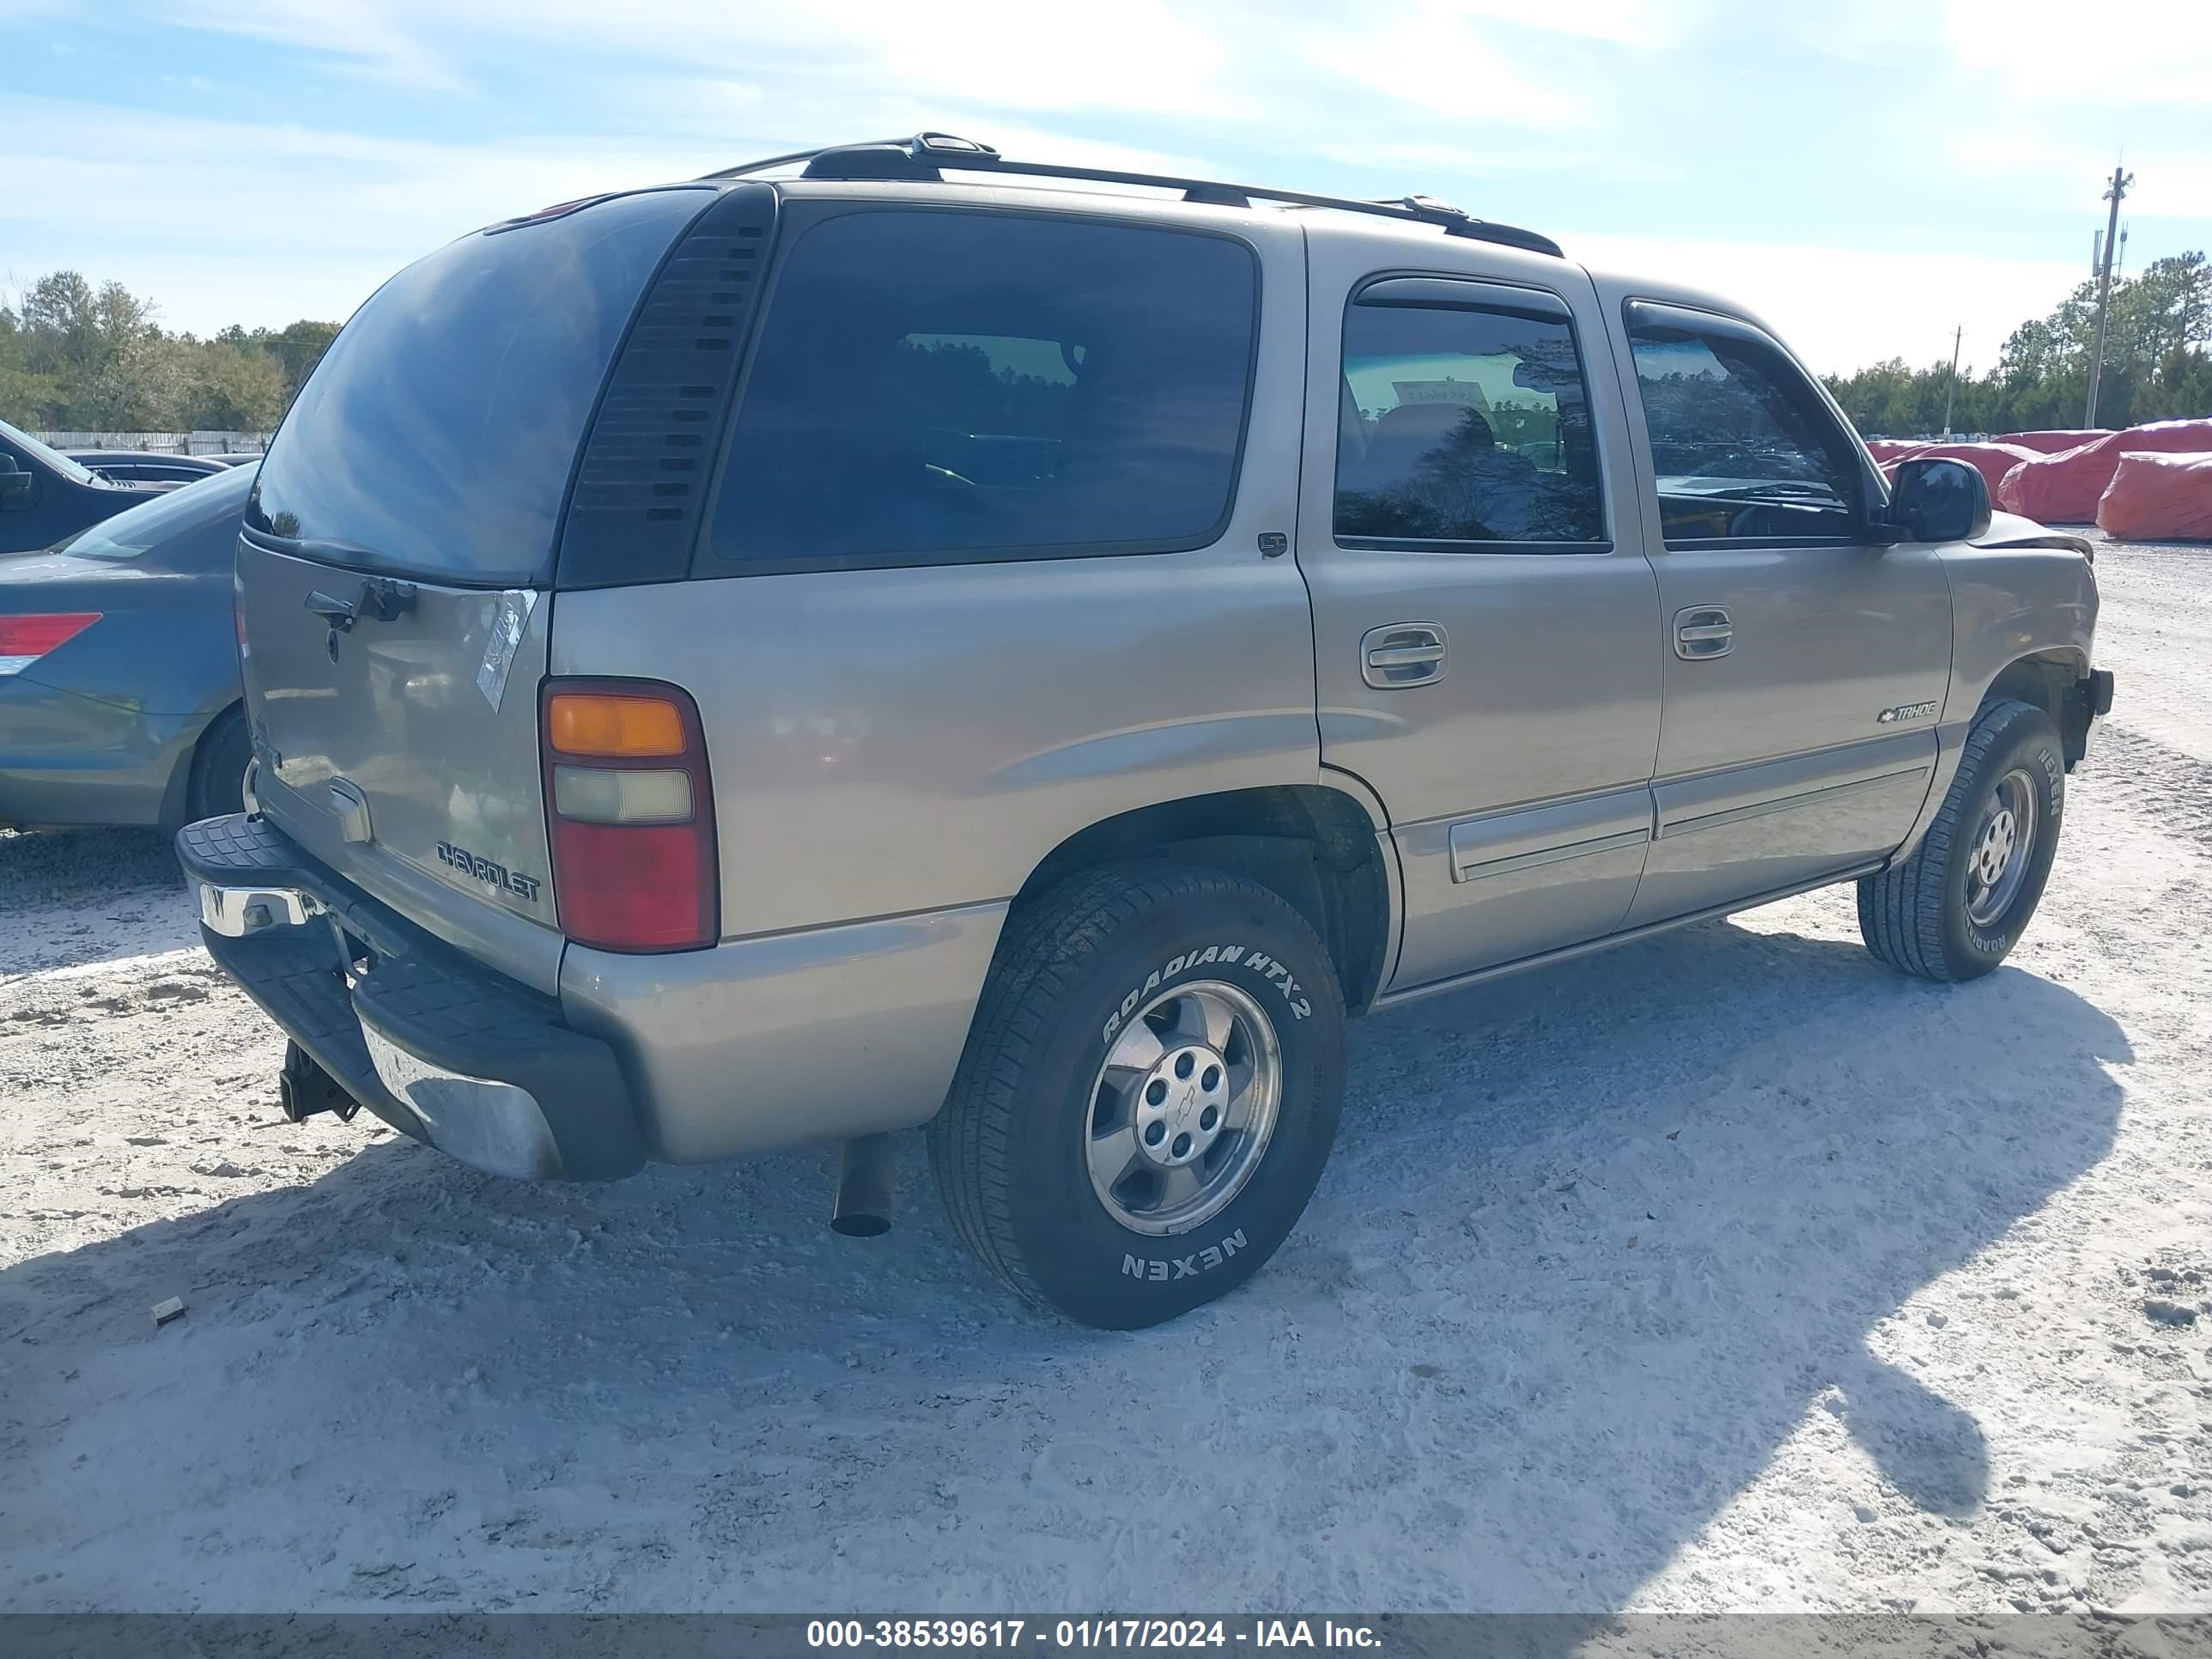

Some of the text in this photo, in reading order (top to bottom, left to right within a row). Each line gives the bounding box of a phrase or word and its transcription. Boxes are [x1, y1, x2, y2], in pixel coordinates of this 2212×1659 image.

[1261, 536, 1285, 550] LT
[1896, 702, 1937, 720] TAHOE
[2038, 749, 2062, 817] NEXEN
[434, 841, 540, 902] CHEVROLET
[1103, 945, 1245, 1045] ROADIAN
[1121, 1227, 1249, 1282] NEXEN
